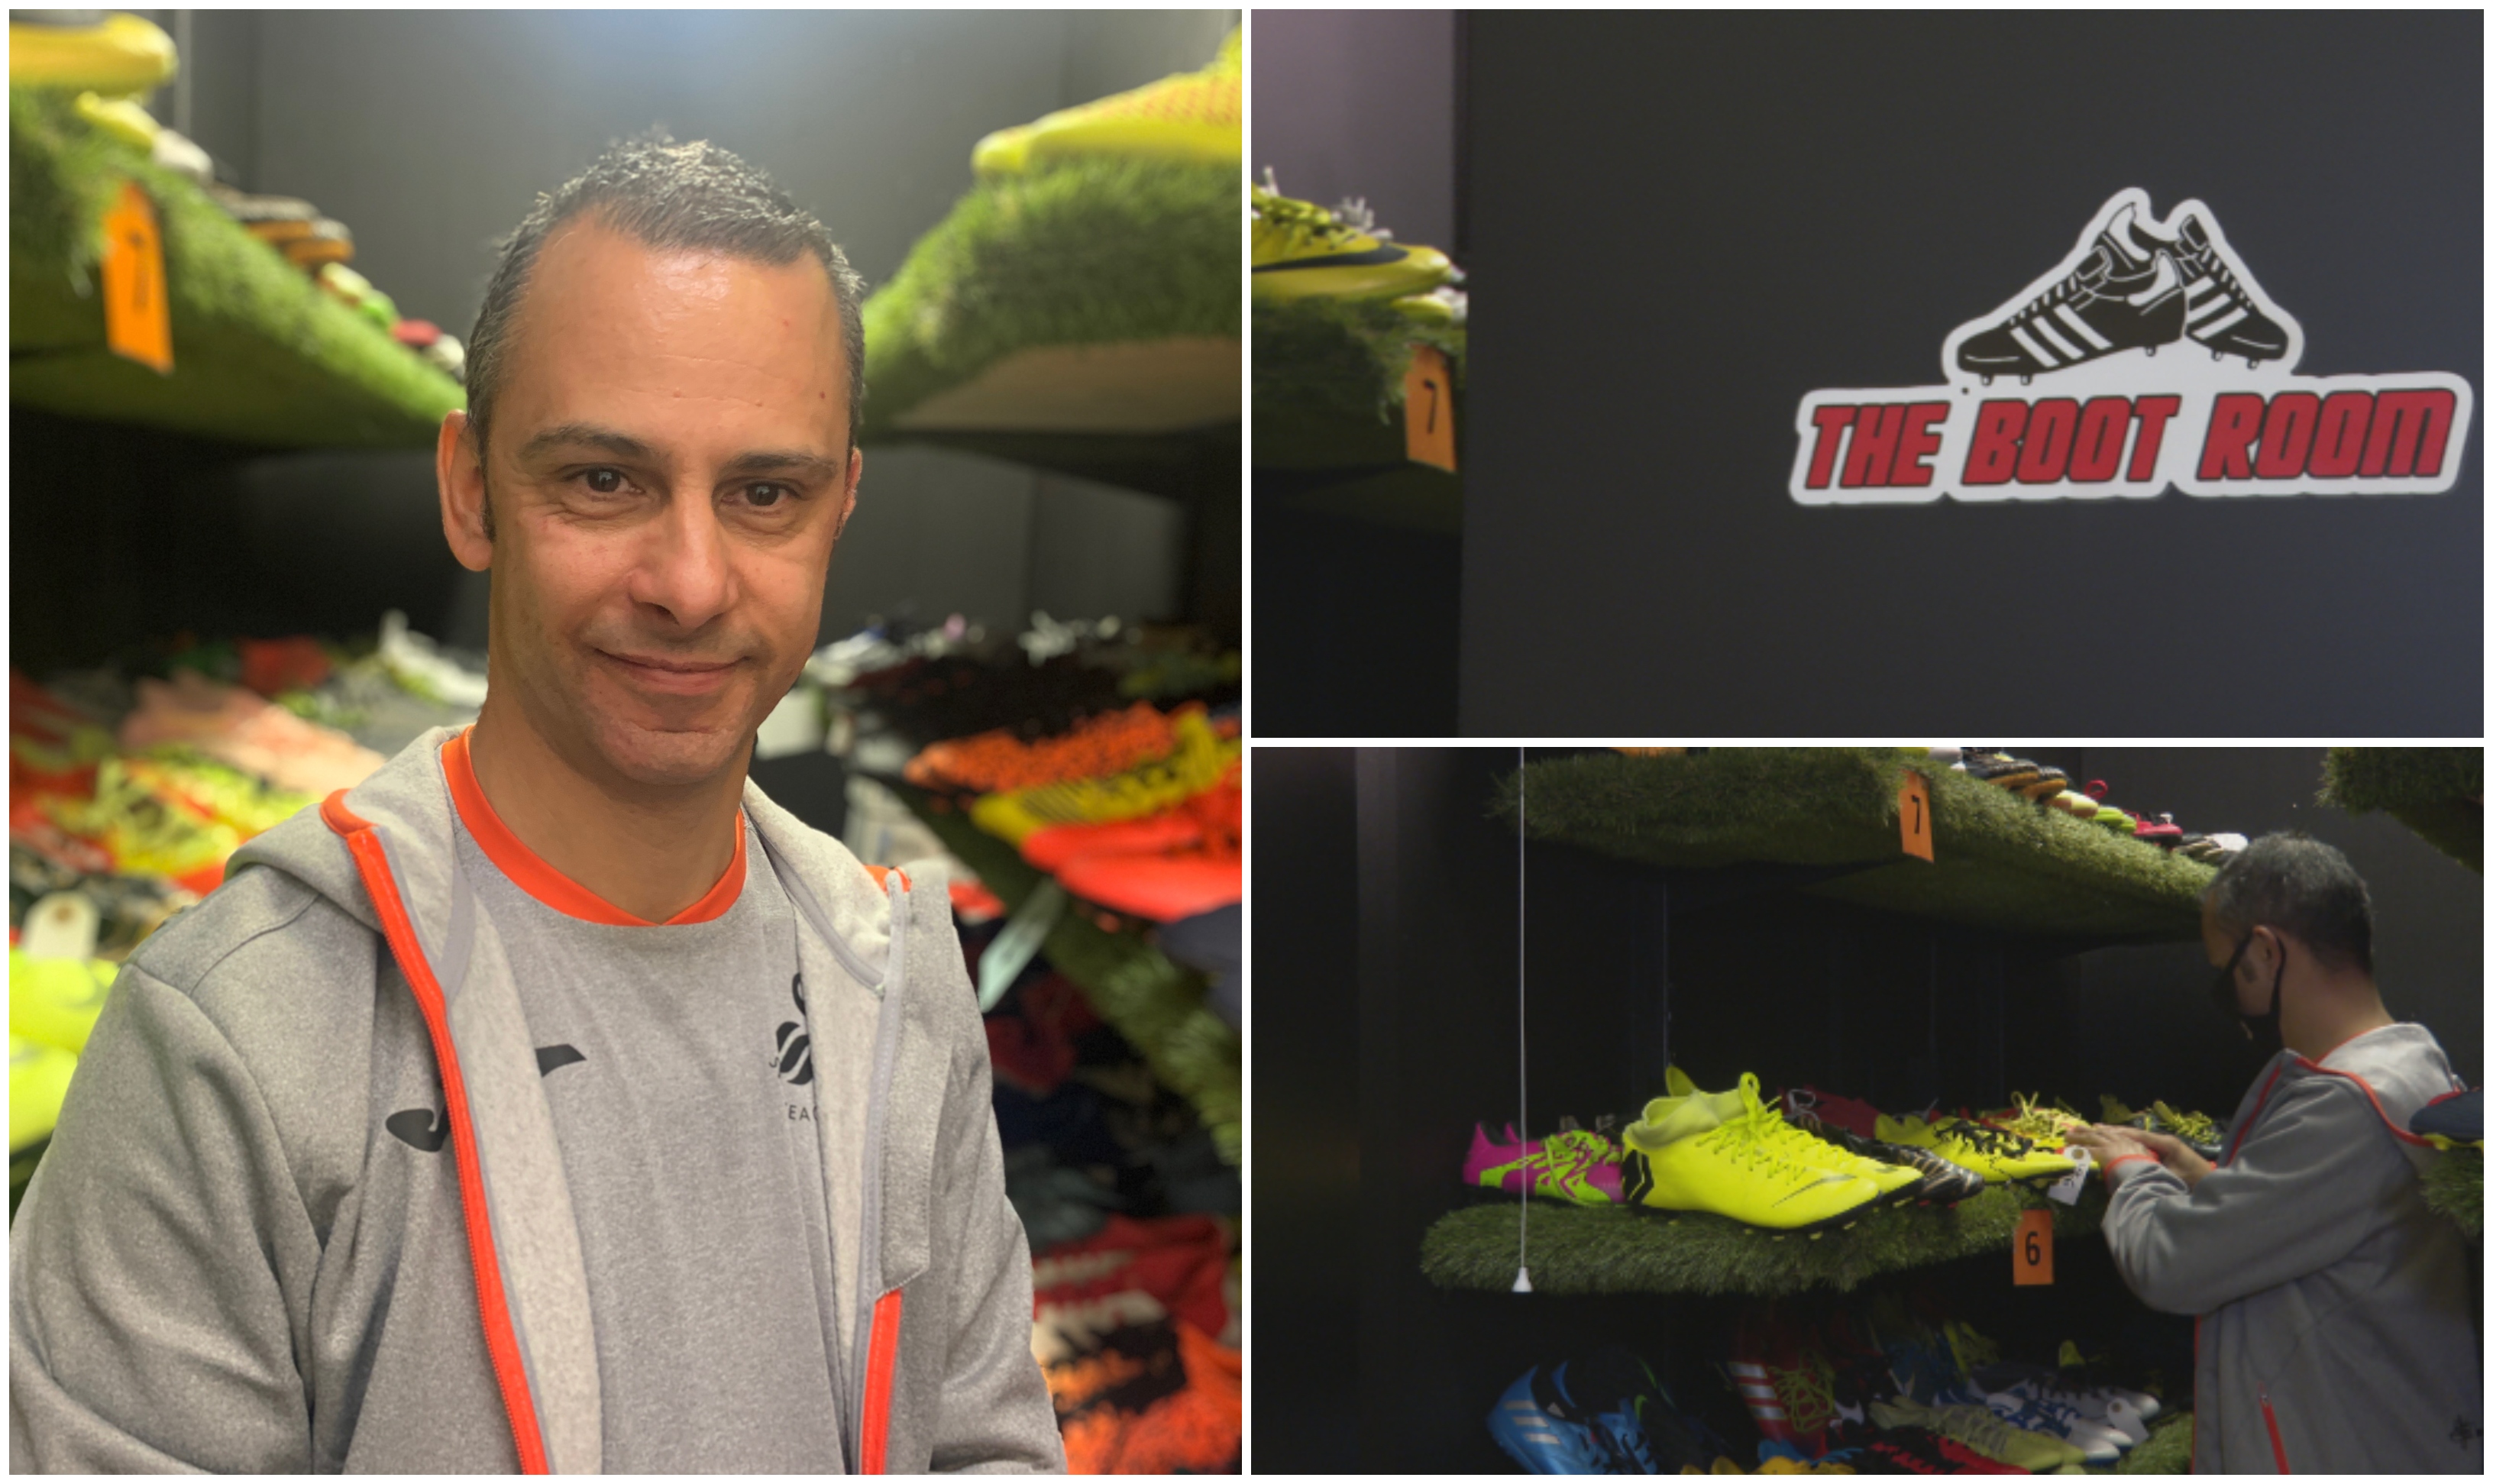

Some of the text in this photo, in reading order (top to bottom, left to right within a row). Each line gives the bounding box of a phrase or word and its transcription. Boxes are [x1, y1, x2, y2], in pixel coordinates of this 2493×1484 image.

[1805, 388, 2457, 489] THE BOOT ROOM
[784, 1101, 818, 1122] EA
[2025, 1230, 2041, 1266] 6
